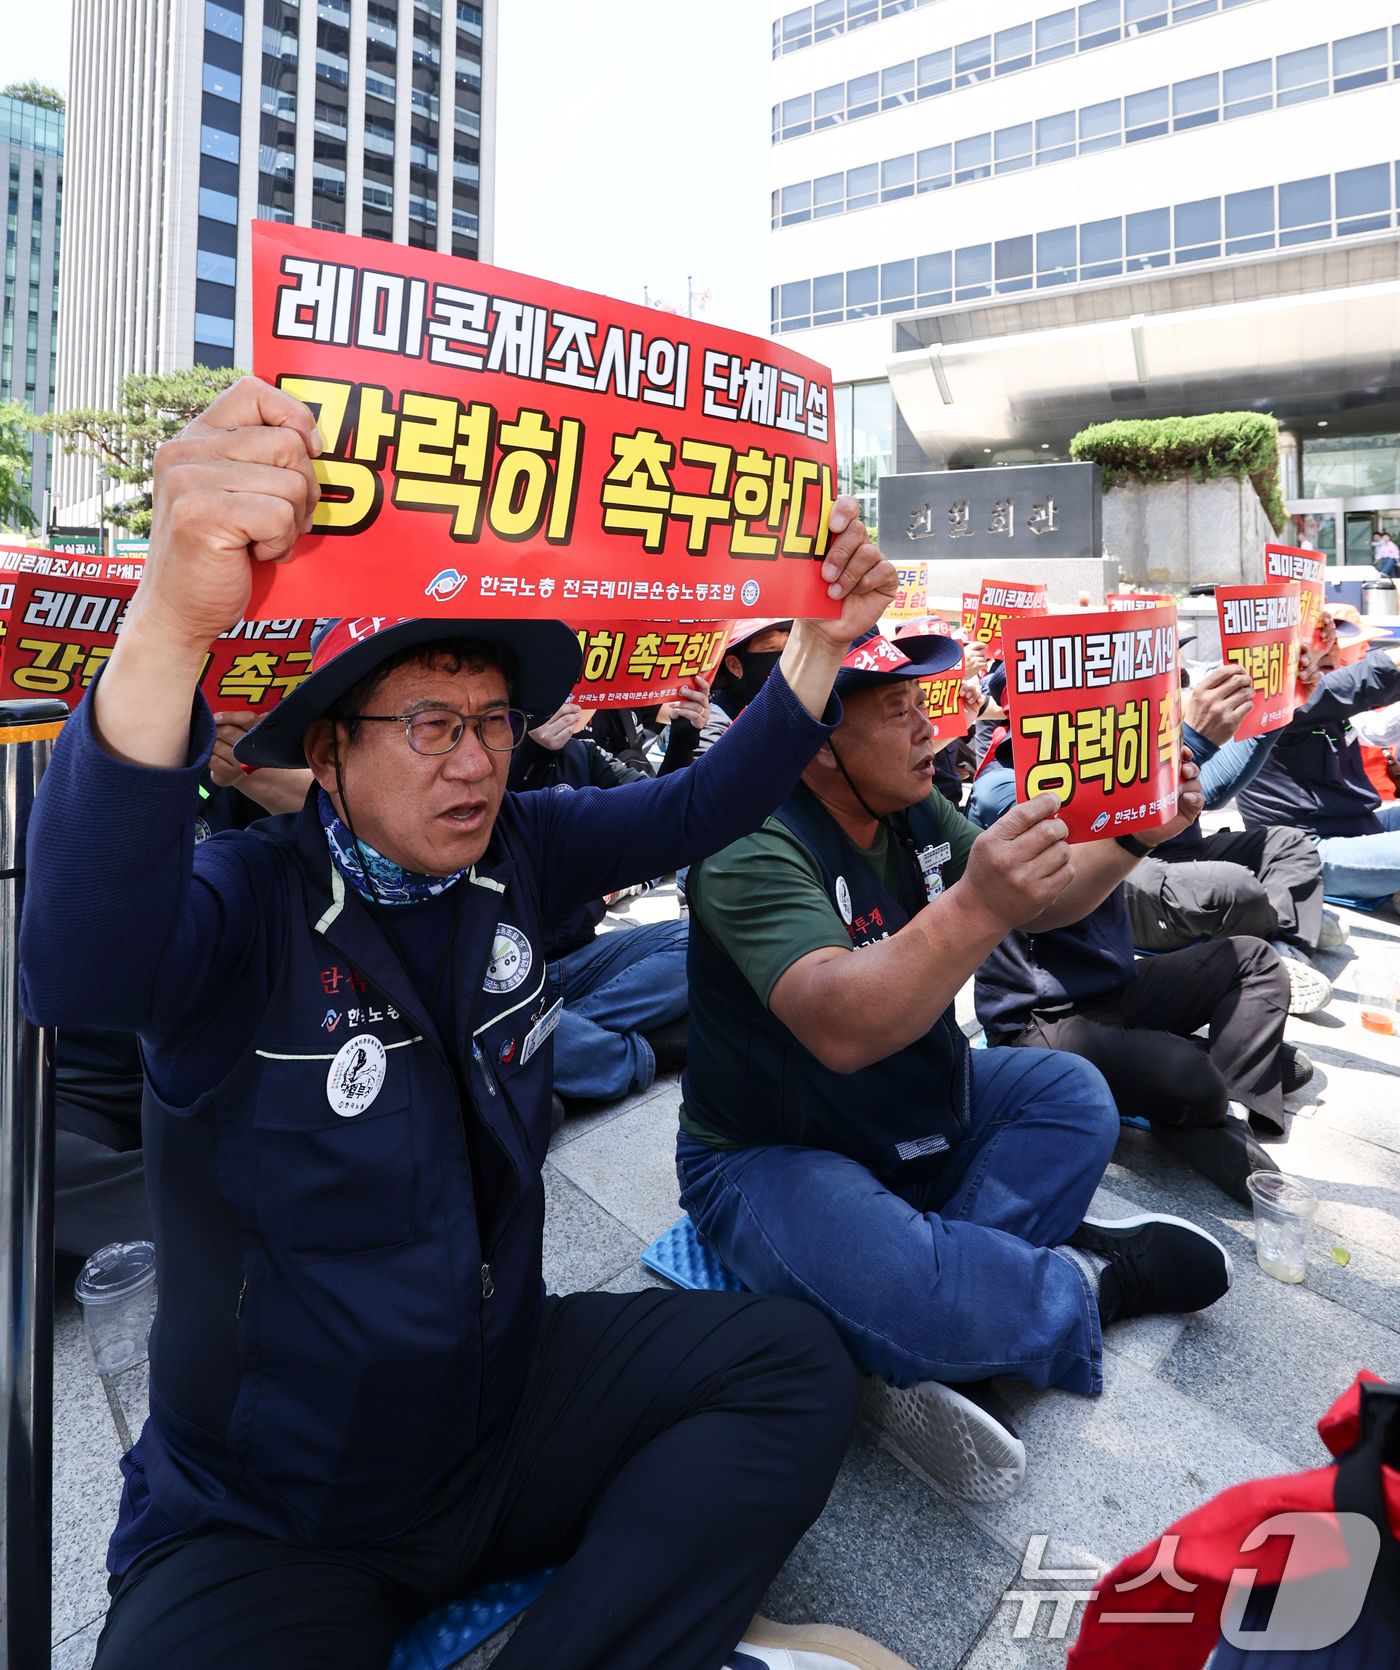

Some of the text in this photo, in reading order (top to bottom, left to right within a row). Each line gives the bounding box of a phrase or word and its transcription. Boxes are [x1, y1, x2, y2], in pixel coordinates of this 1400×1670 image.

[273, 254, 830, 443] 레미콘제조사의 단체교섭
[277, 373, 834, 560] 강력히 촉구한다
[480, 575, 556, 599] 한국노총
[562, 578, 737, 601] 전국레미콘운송노동조합
[628, 629, 730, 681] 촉구한다
[1021, 698, 1149, 808] 강력히
[1114, 802, 1147, 826] 한국노총
